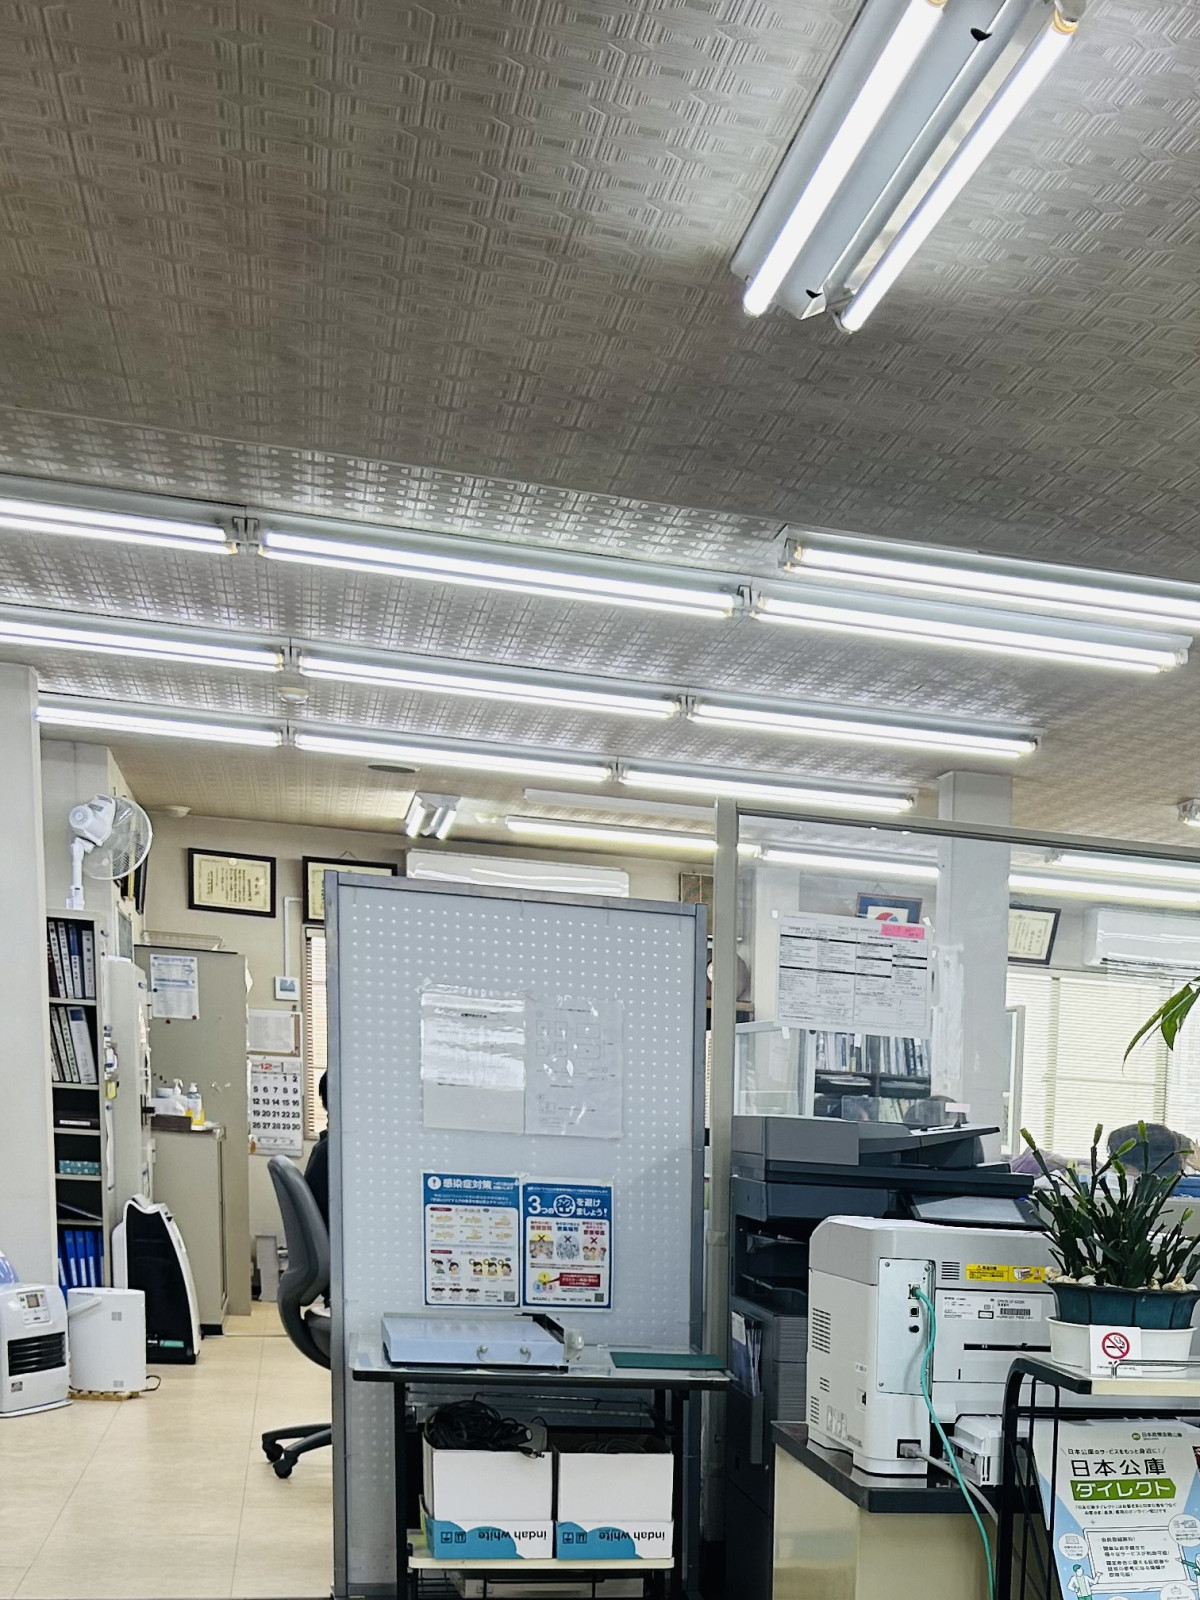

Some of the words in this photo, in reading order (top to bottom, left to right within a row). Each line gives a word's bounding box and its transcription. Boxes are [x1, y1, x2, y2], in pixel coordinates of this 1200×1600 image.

[1071, 1458, 1166, 1476] 日本公庫
[1076, 1482, 1171, 1498] ダイレクト
[478, 1530, 512, 1540] white
[514, 1530, 547, 1541] indah
[598, 1530, 630, 1541] white
[633, 1531, 666, 1542] indah
